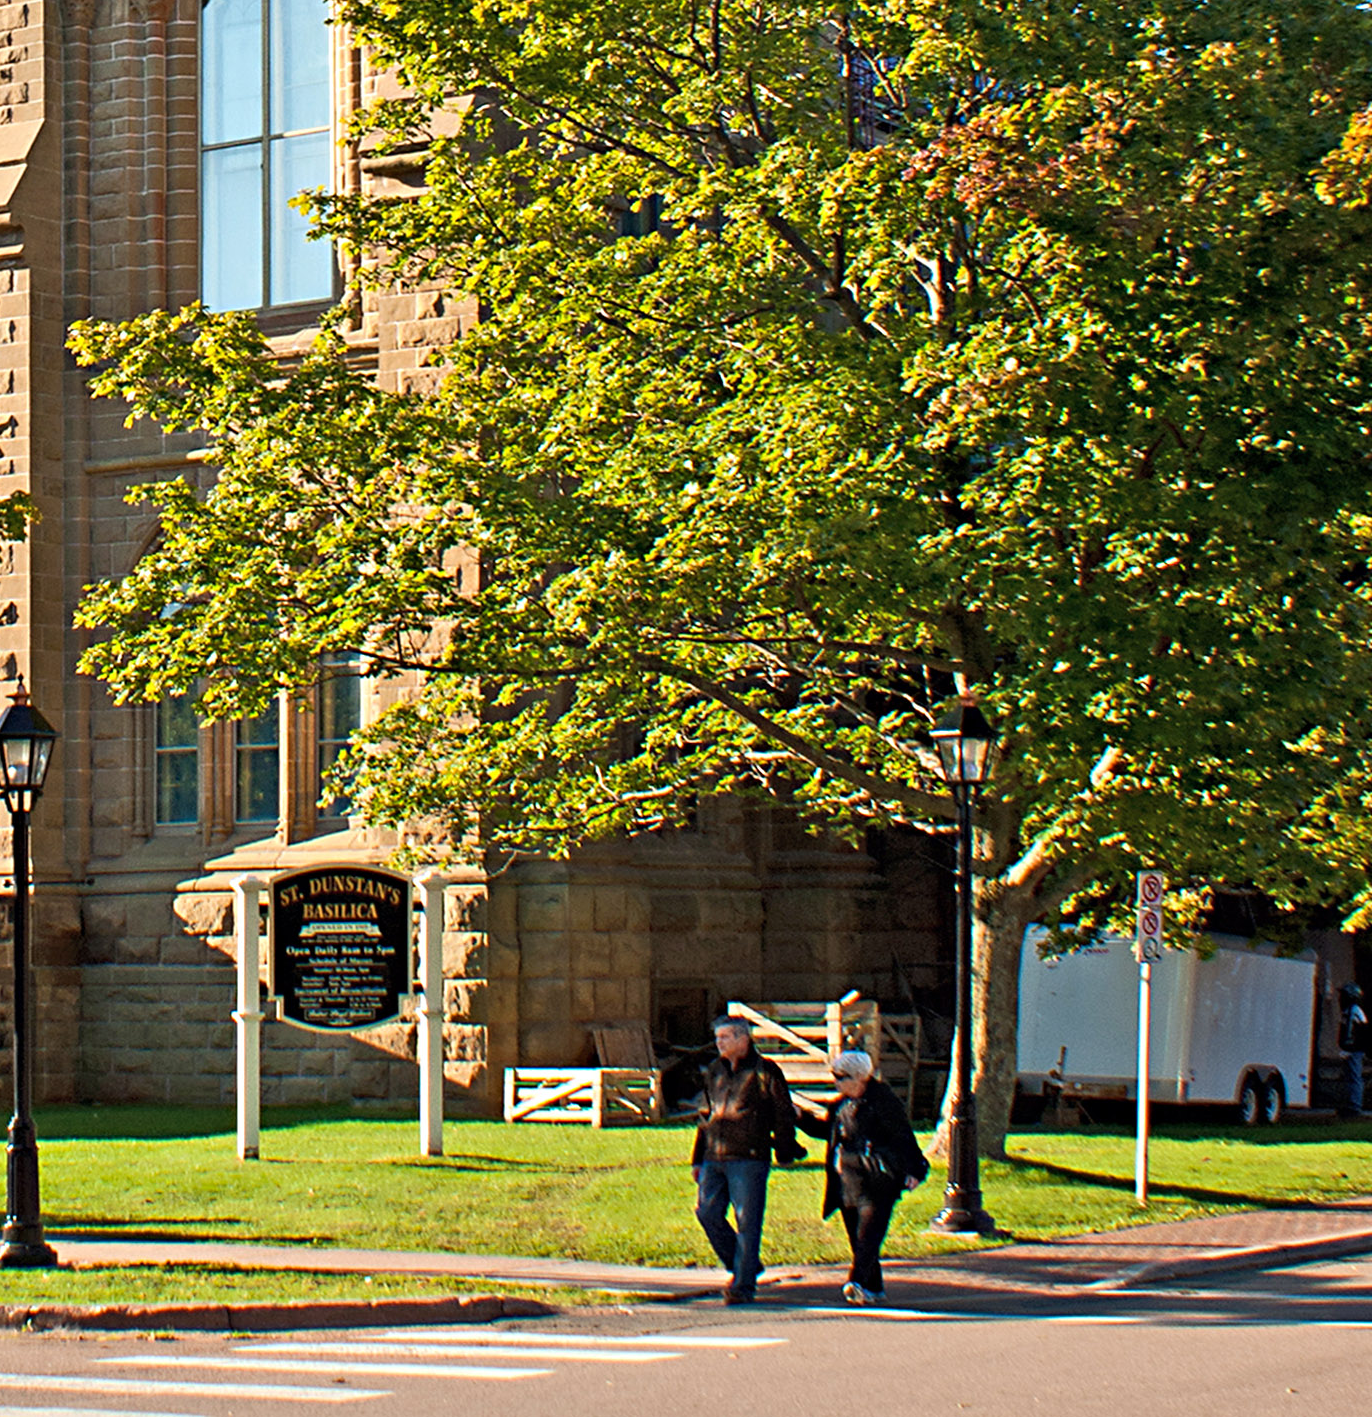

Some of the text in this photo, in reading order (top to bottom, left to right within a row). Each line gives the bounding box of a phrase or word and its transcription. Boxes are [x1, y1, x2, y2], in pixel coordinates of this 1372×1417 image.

[280, 875, 401, 906] ST. DUNSTAN'S
[303, 903, 378, 919] BASILICA
[286, 946, 310, 957] Open
[315, 945, 337, 956] Daily
[364, 946, 373, 955] to
[376, 944, 395, 957] 5pm
